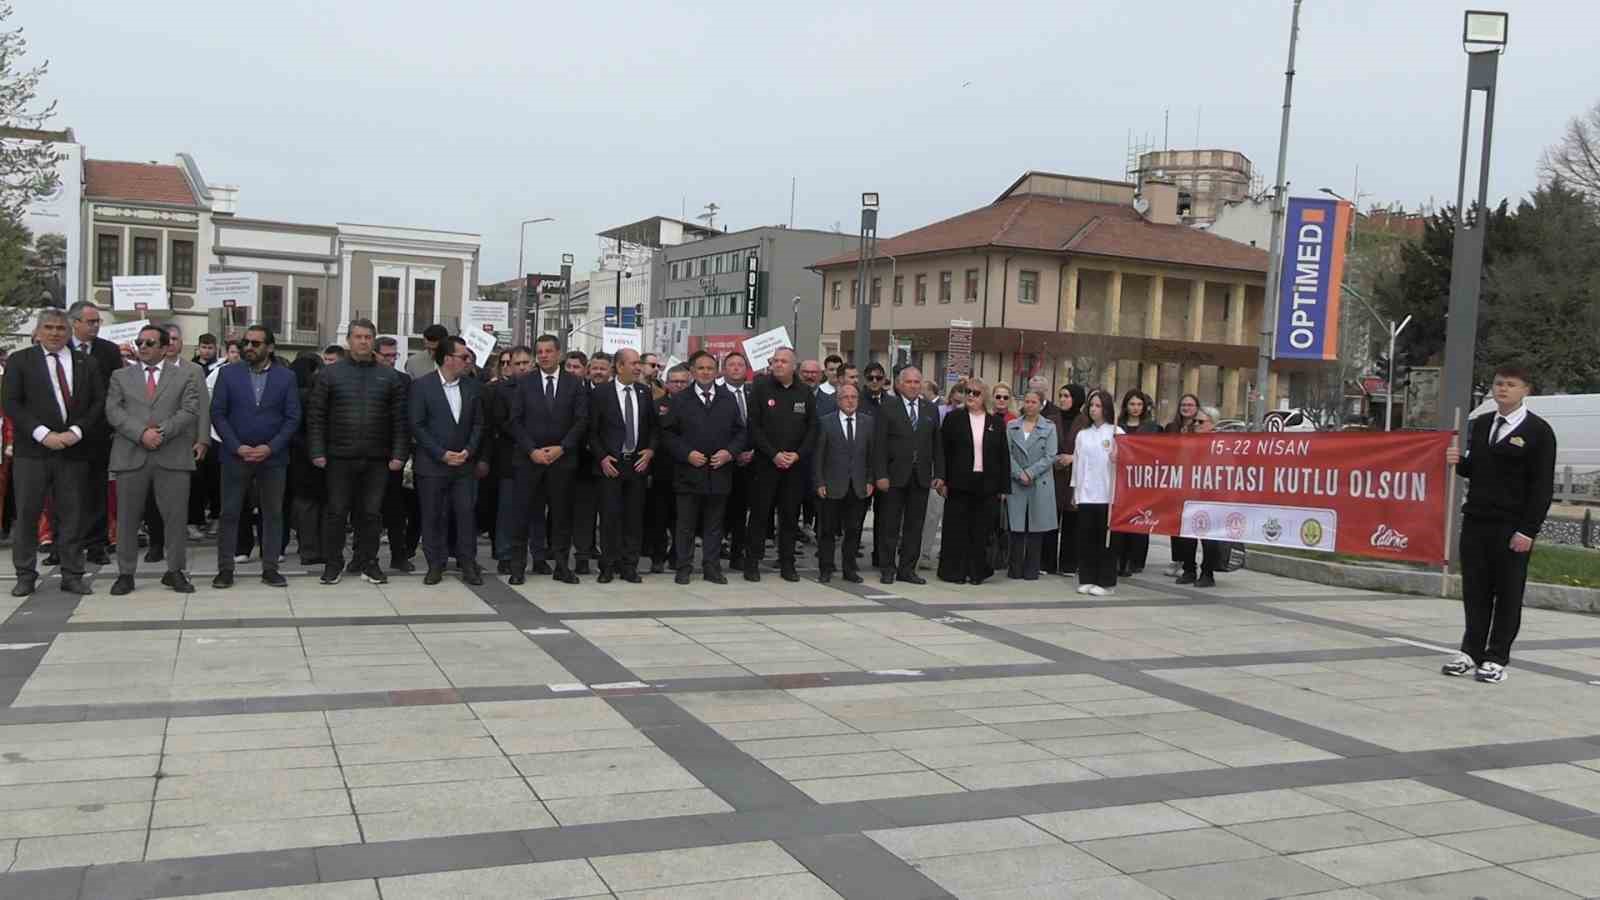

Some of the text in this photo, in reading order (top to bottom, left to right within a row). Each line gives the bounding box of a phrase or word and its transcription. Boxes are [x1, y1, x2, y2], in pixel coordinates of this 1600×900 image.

[748, 257, 757, 328] HOTEL
[1210, 437, 1310, 456] 15-22 NİSAN
[1126, 460, 1426, 502] TURİZM HAFTASI KUTLU OLSUN
